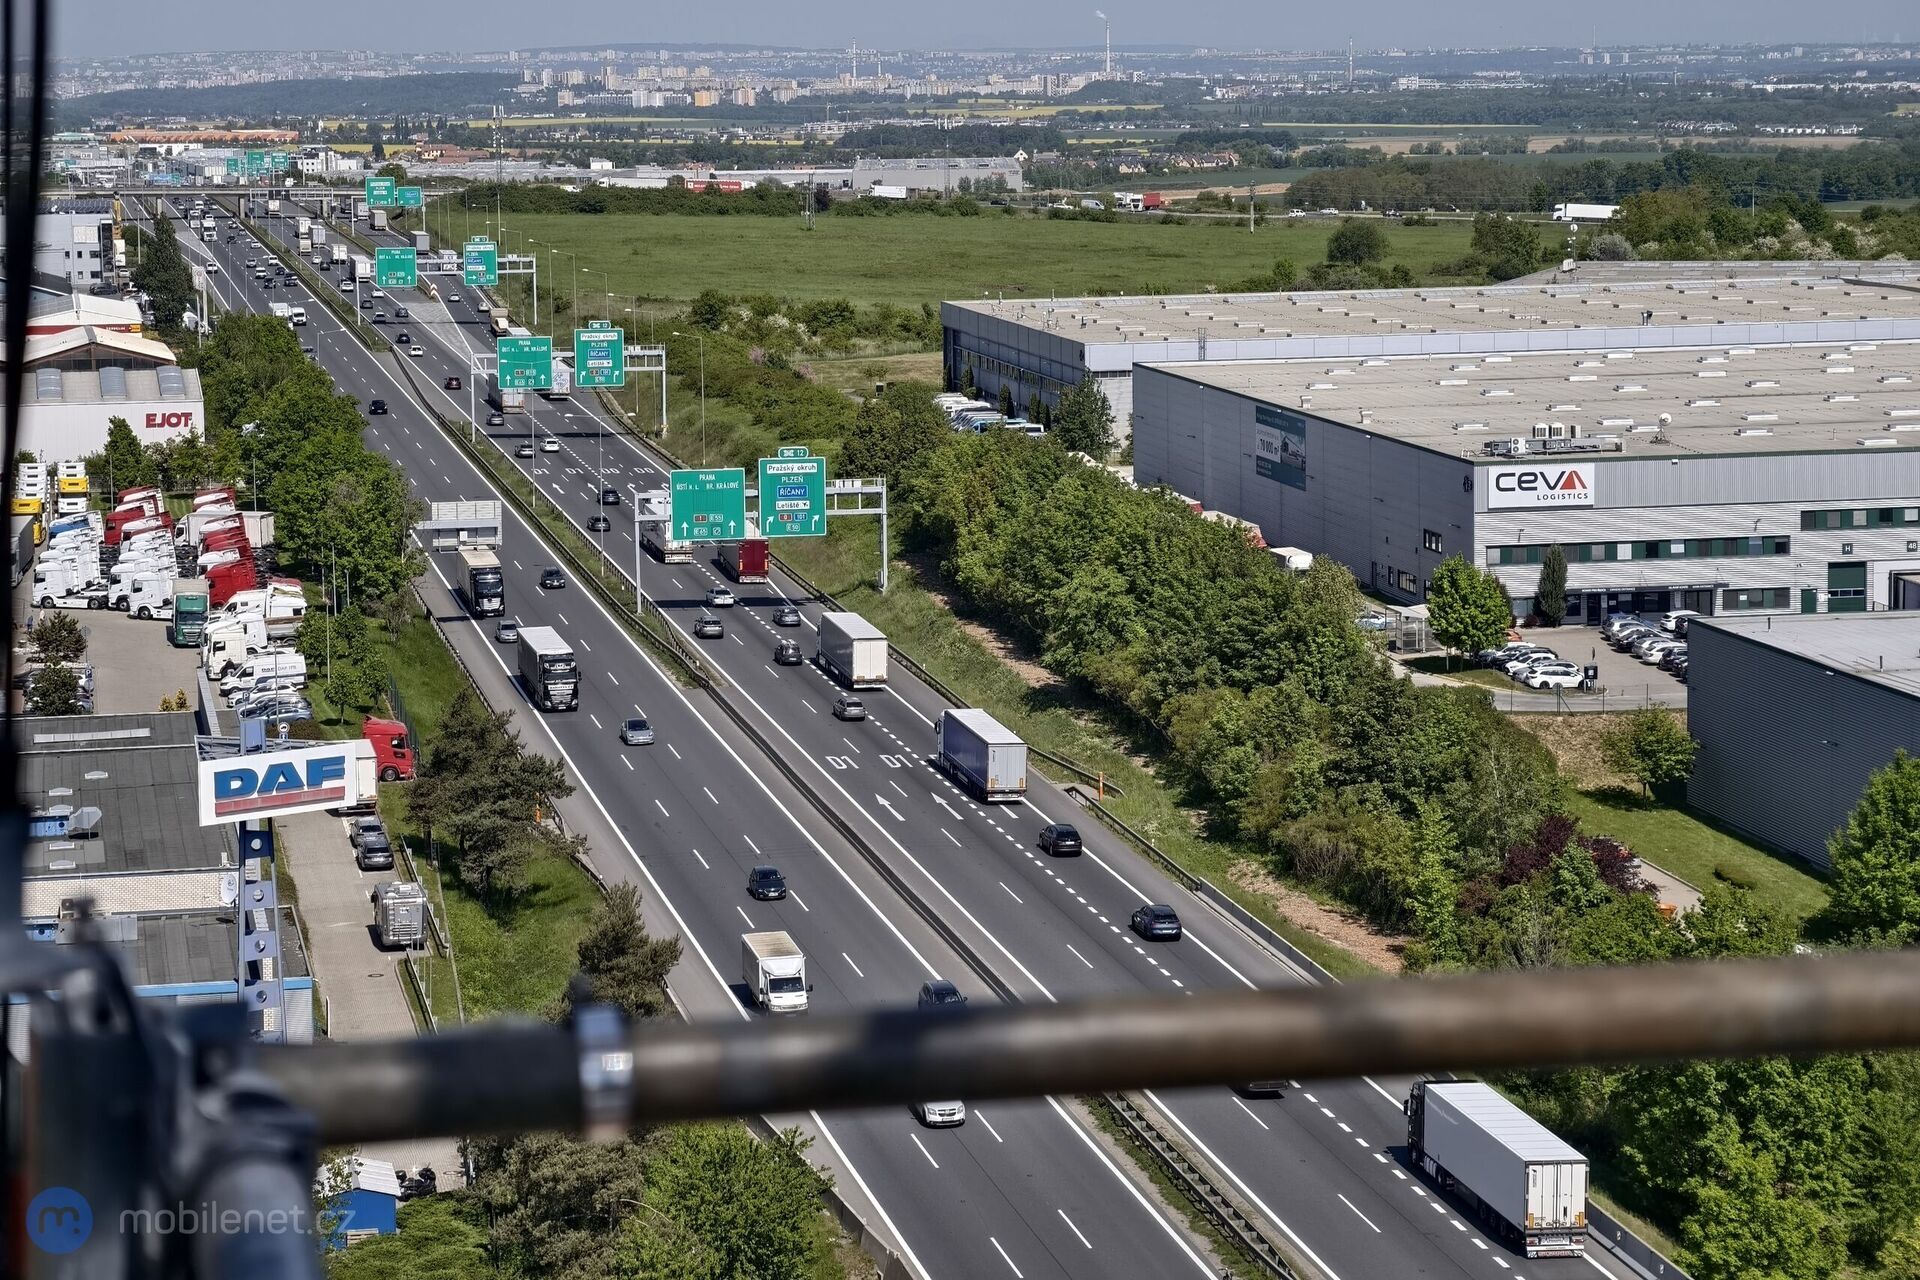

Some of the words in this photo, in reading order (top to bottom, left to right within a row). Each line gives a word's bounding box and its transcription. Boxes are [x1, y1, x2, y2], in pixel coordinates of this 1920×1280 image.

[145, 412, 193, 429] EJOT
[781, 474, 804, 483] PLZEŇ
[716, 481, 739, 489] KRÁLOVÉ
[780, 488, 805, 496] ŘÍČANY
[1536, 492, 1589, 501] LOGISTICS
[825, 756, 860, 770] D1
[879, 754, 914, 768] D1
[214, 755, 346, 802] DAF
